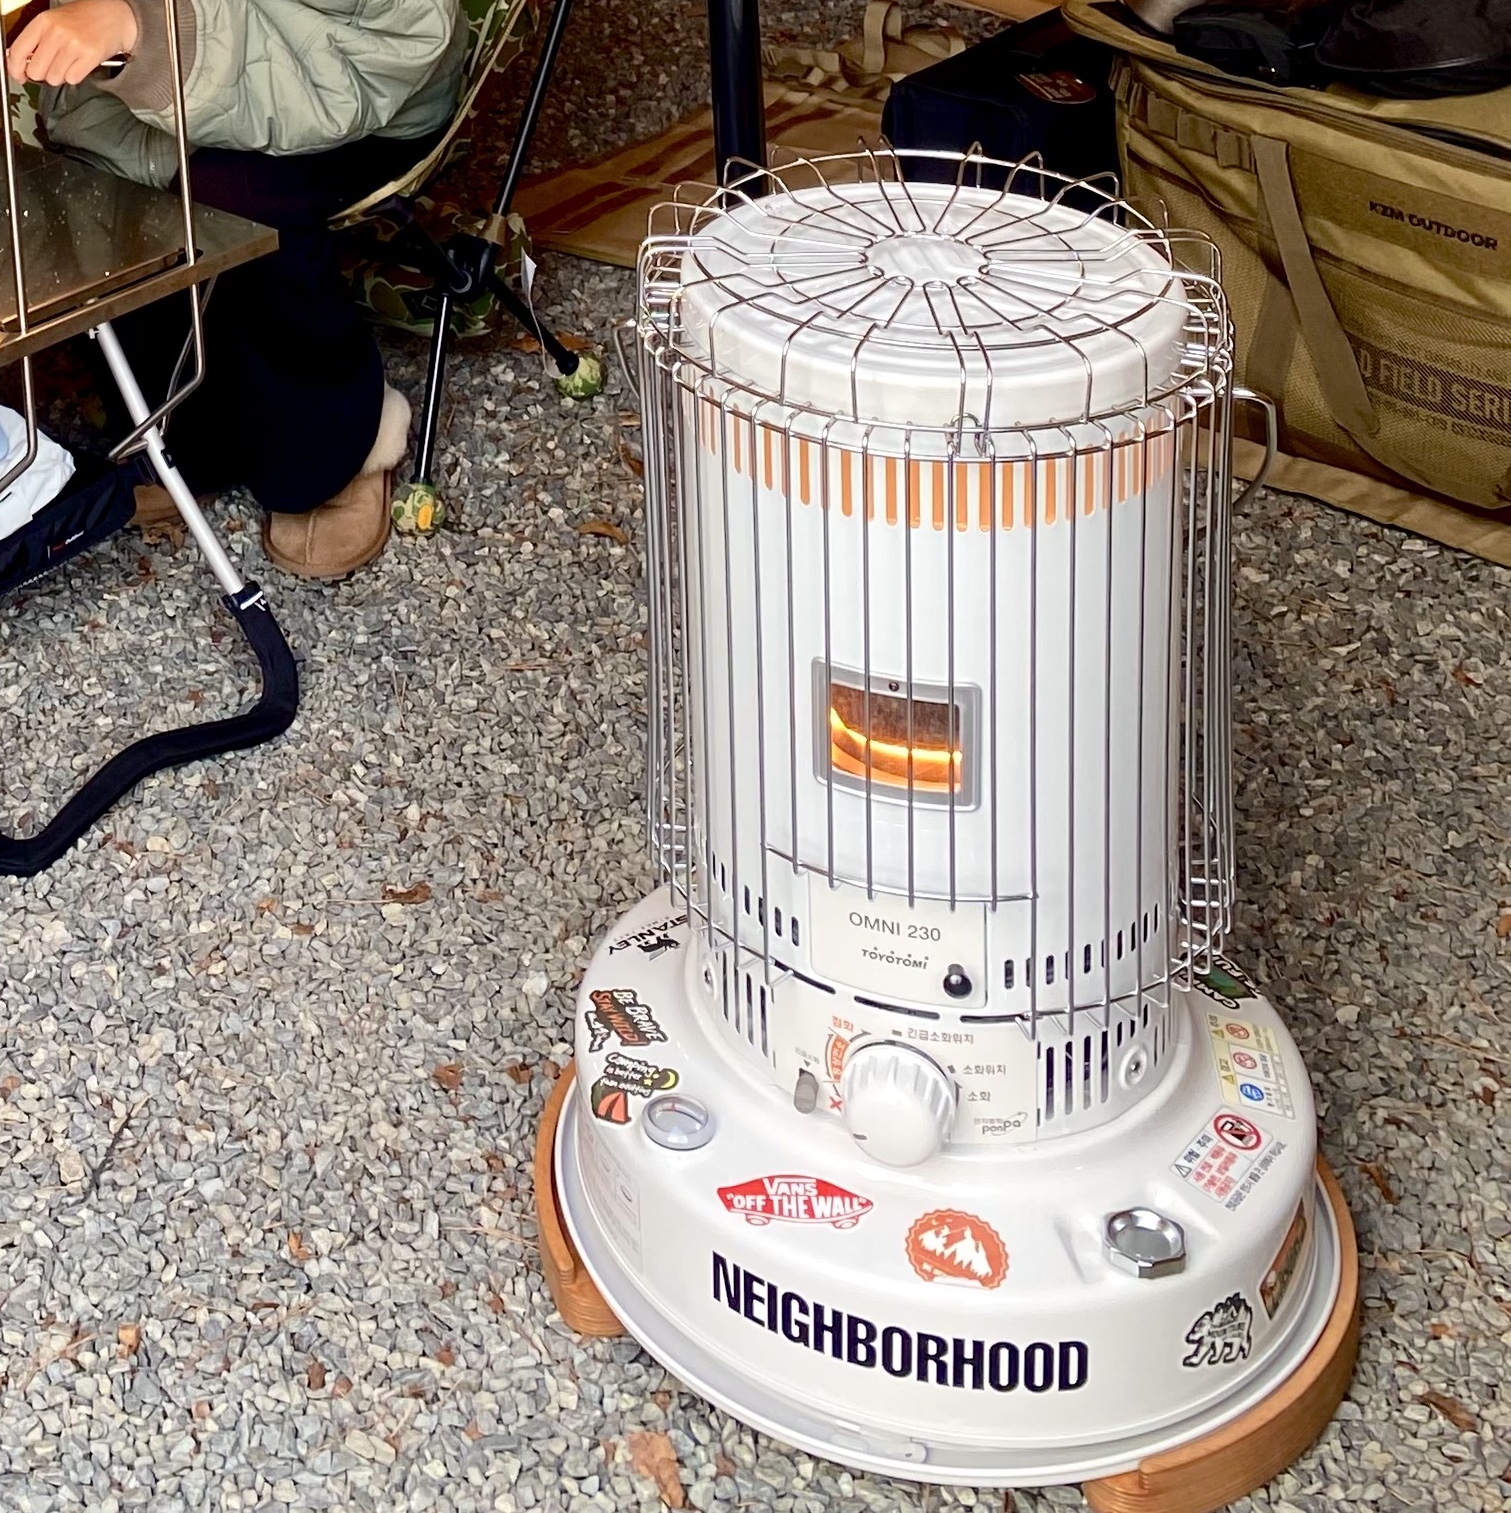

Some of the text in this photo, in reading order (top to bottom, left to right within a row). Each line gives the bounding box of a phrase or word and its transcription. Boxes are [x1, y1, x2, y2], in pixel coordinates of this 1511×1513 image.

[1408, 213, 1498, 251] OUTDOOR
[608, 914, 688, 956] STANLEY
[848, 911, 942, 943] OMNI 230
[612, 989, 666, 1042] BE BRAVE
[907, 1028, 975, 1045] 긴급소화위치
[963, 1064, 1007, 1076] 소화위치
[967, 1091, 991, 1102] 소화
[762, 1177, 819, 1197] VANS
[768, 1195, 810, 1219] THE
[711, 1250, 1089, 1393] NEIGHBORHOOD
